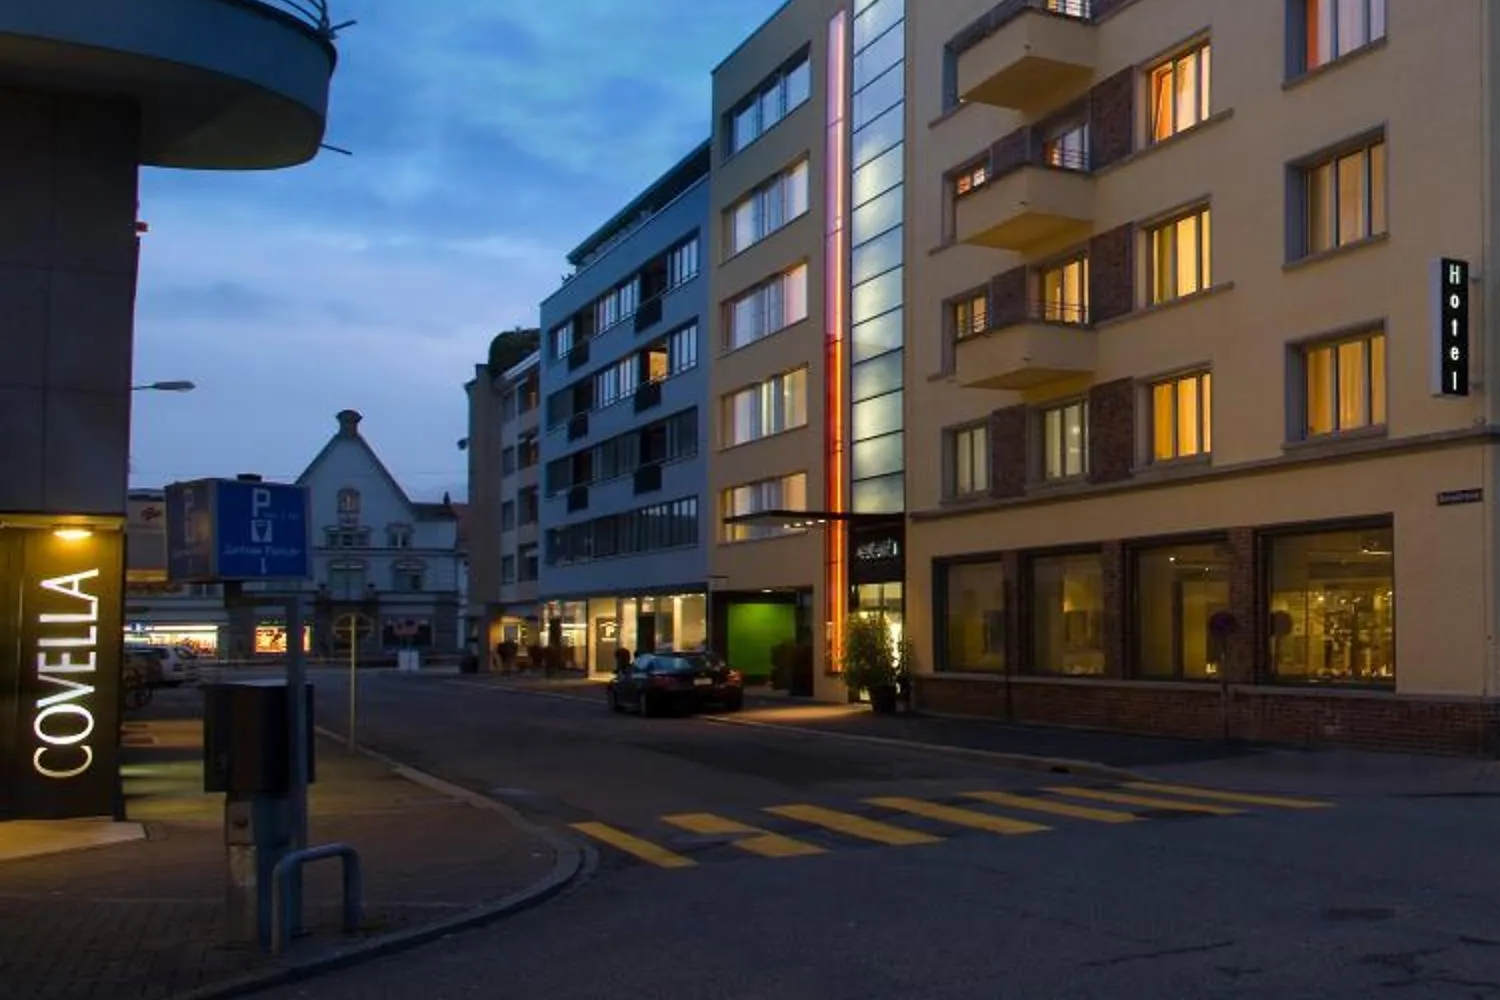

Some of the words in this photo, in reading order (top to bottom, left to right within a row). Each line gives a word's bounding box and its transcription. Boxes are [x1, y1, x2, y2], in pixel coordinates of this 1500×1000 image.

[1448, 263, 1462, 391] Hotel
[252, 487, 271, 517] P
[33, 568, 99, 778] COVELLA
